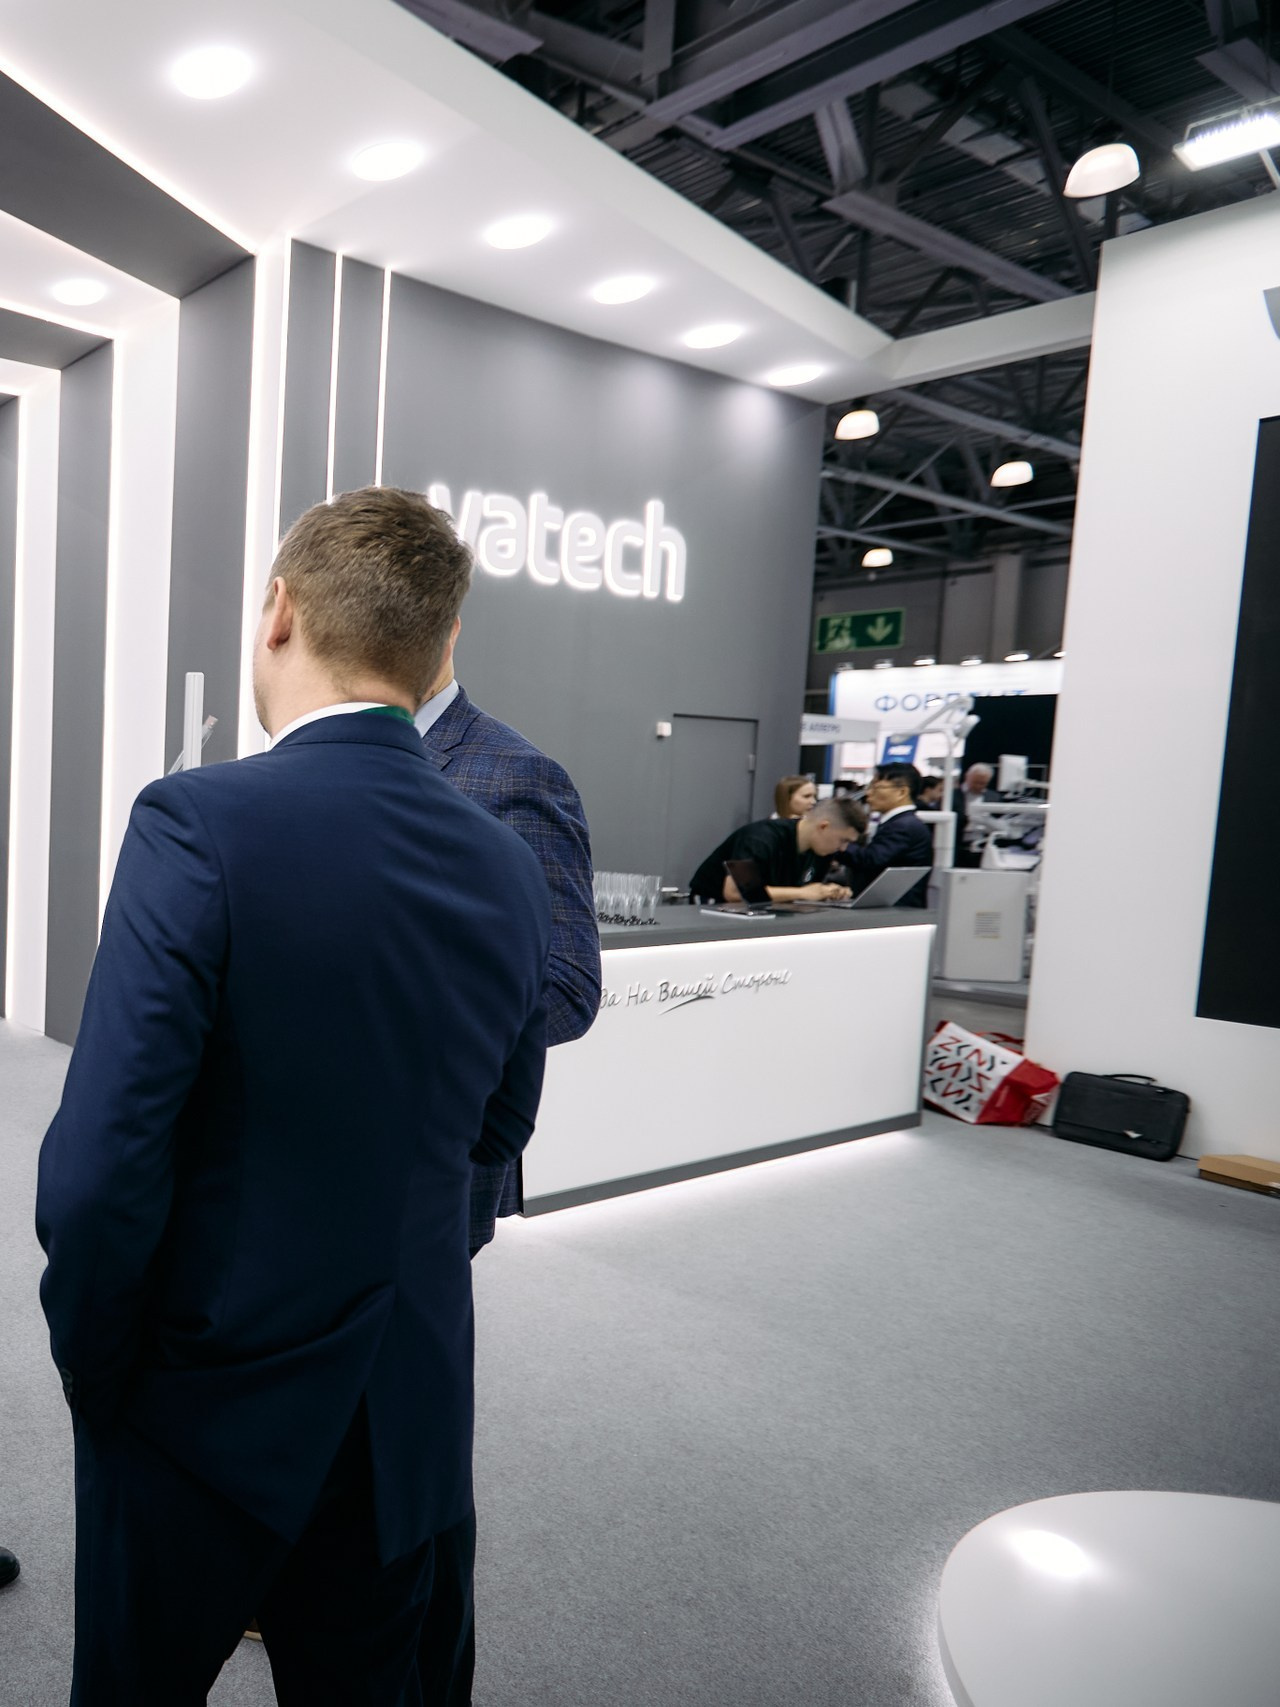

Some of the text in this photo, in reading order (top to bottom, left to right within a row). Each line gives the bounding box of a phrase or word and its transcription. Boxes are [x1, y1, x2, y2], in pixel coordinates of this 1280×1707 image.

[428, 483, 688, 602] vatech
[626, 981, 652, 1007] На
[657, 976, 717, 1003] Вашей
[721, 969, 792, 996] Стороне
